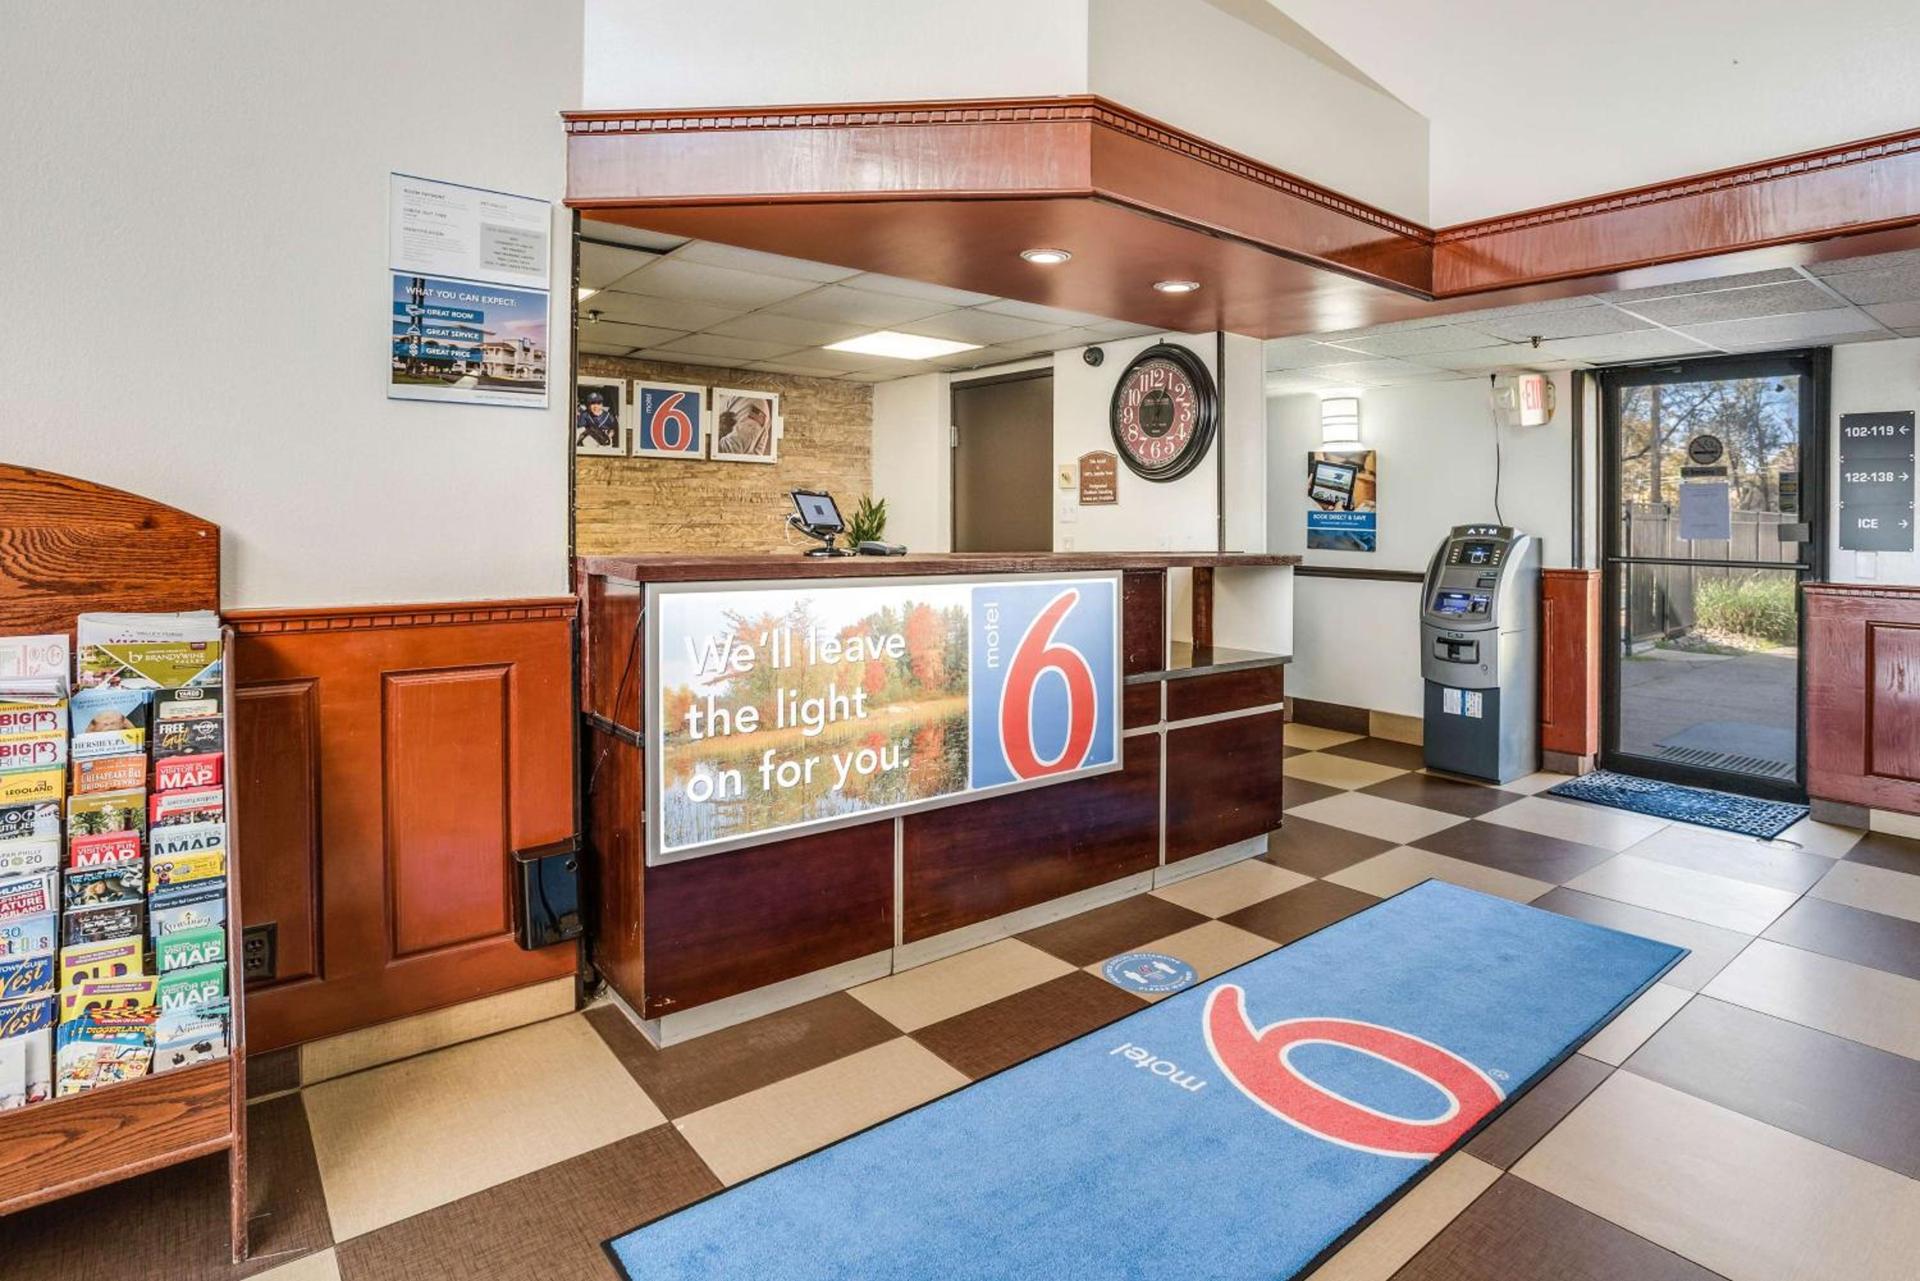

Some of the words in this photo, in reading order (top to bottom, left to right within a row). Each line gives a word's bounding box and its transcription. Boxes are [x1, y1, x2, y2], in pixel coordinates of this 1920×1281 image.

[405, 286, 433, 297] WHAT
[437, 290, 456, 300] YOU
[459, 293, 479, 303] CAN
[427, 308, 449, 317] GREAT
[452, 311, 474, 319] ROOM
[426, 328, 449, 336] GREAT
[451, 331, 479, 340] SERVICE
[426, 347, 449, 356] GREAT
[451, 350, 471, 358] PRICE
[1140, 374, 1149, 392] 11
[1150, 368, 1164, 387] 12
[1168, 372, 1173, 390] 1
[1129, 388, 1140, 406] 10
[1175, 383, 1185, 402] 2
[1124, 406, 1133, 424] 9
[1181, 403, 1191, 421] 3
[651, 393, 692, 453] 6
[1175, 423, 1186, 440] 4
[1128, 424, 1138, 442] 8
[1139, 436, 1148, 454] 7
[1151, 440, 1160, 458] 6
[1164, 436, 1174, 454] 5
[1858, 518, 1879, 529] ICE
[984, 603, 999, 669] motel
[146, 652, 205, 662] BRANDYWINE
[685, 627, 792, 677] We'll
[806, 625, 906, 667] leave
[998, 587, 1098, 781] 6
[0, 712, 31, 726] BIG
[685, 695, 760, 739] the
[777, 683, 868, 737] light
[160, 722, 185, 734] FREE
[0, 743, 31, 757] BIG
[196, 763, 213, 771] FUN
[687, 768, 743, 802] on
[759, 749, 820, 791] for
[160, 769, 213, 790] MAP
[6, 784, 53, 795] LEGOLAND
[77, 843, 114, 855] VISITOR
[116, 842, 136, 851] FUN
[26, 855, 42, 864] 20
[77, 849, 136, 868] MAP
[164, 946, 220, 970] MAP
[161, 982, 198, 995] VISITOR
[200, 978, 220, 988] FUN
[161, 986, 219, 1011] MAP
[1109, 1042, 1207, 1092] motel
[1202, 983, 1506, 1160] 6
